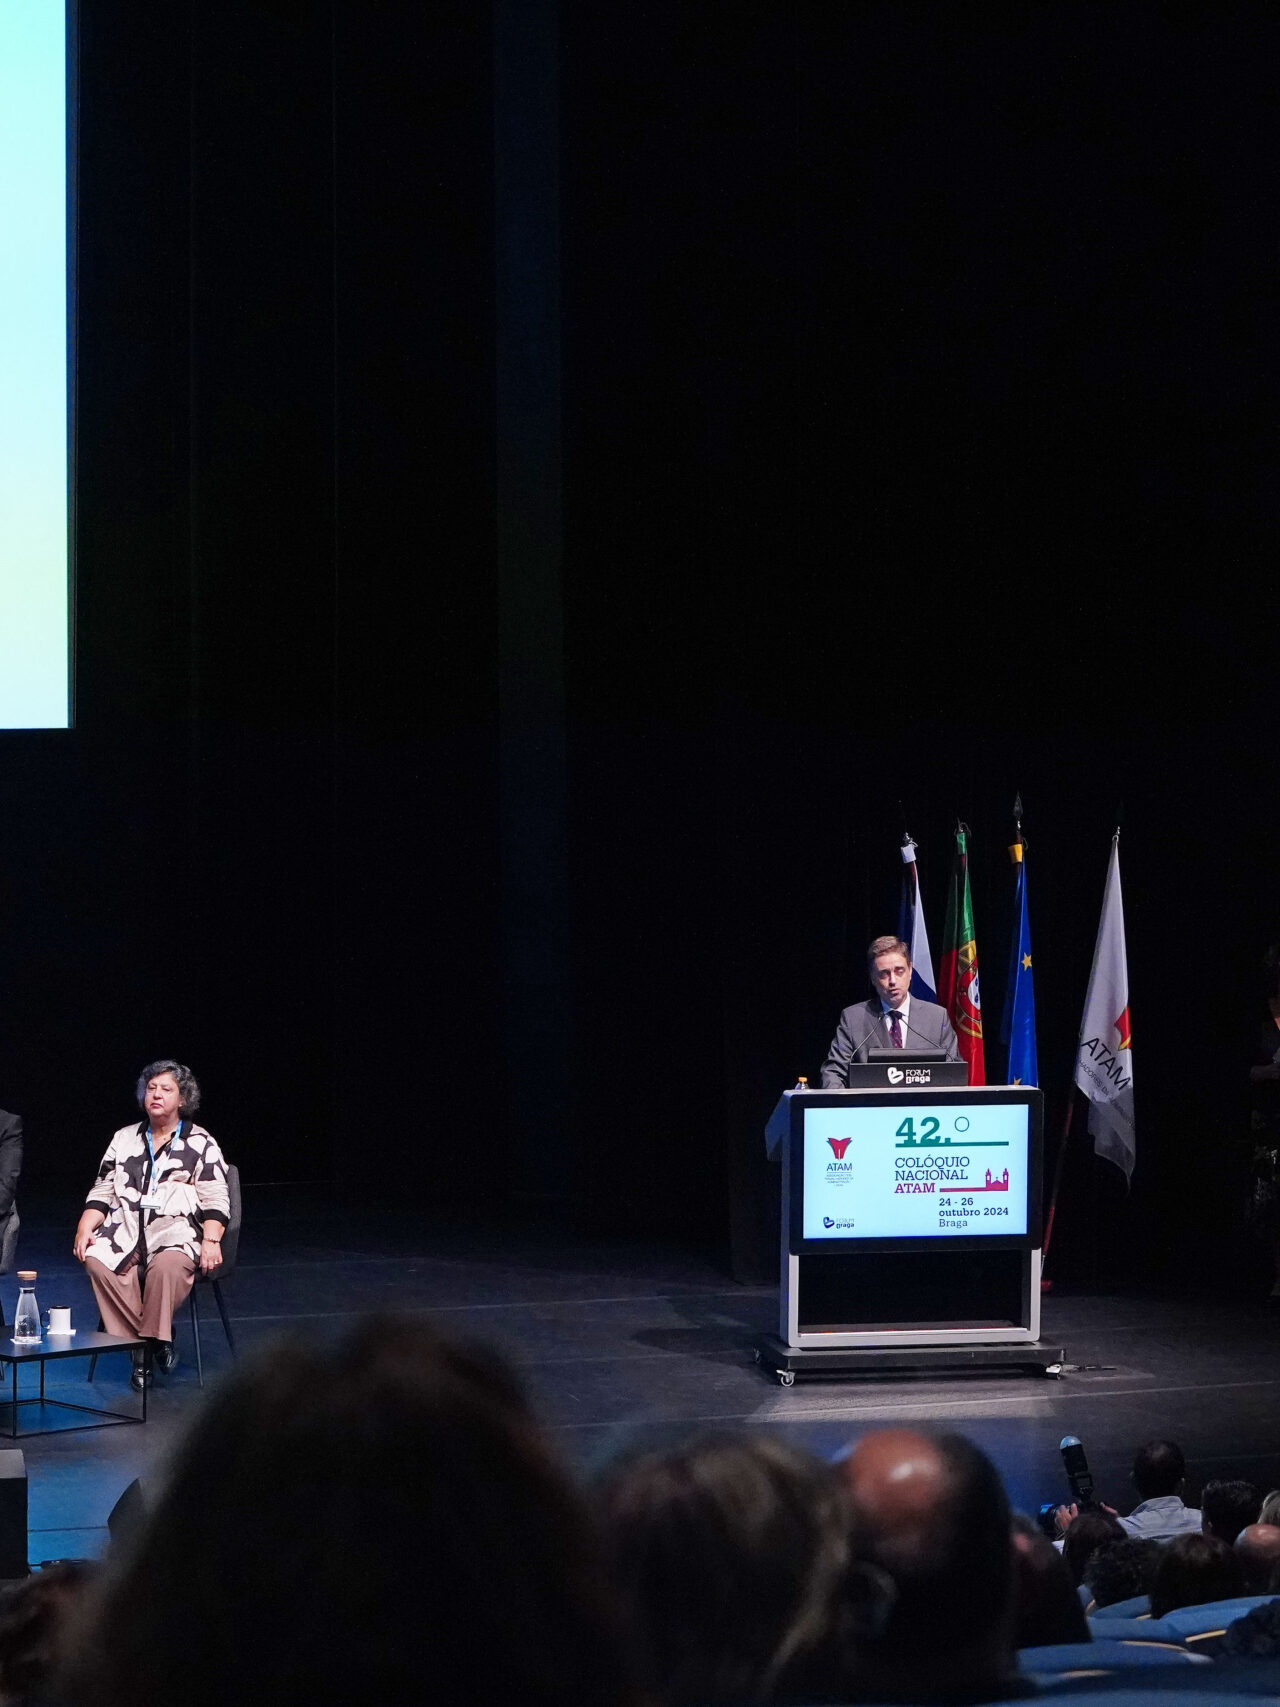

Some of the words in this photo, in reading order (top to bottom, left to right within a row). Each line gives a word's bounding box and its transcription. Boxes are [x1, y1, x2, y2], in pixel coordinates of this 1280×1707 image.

[1081, 1037, 1131, 1091] ATAM
[905, 1069, 931, 1077] FORUM
[826, 1162, 853, 1171] ATAM
[894, 1154, 970, 1169] COLÓQUIO
[894, 1169, 968, 1181] NACIONAL
[894, 1183, 935, 1194] ATAM
[939, 1198, 951, 1206] 24
[961, 1198, 974, 1206] 26
[939, 1208, 981, 1217] outubro
[983, 1207, 1009, 1216] 2024
[939, 1218, 968, 1228] Braga
